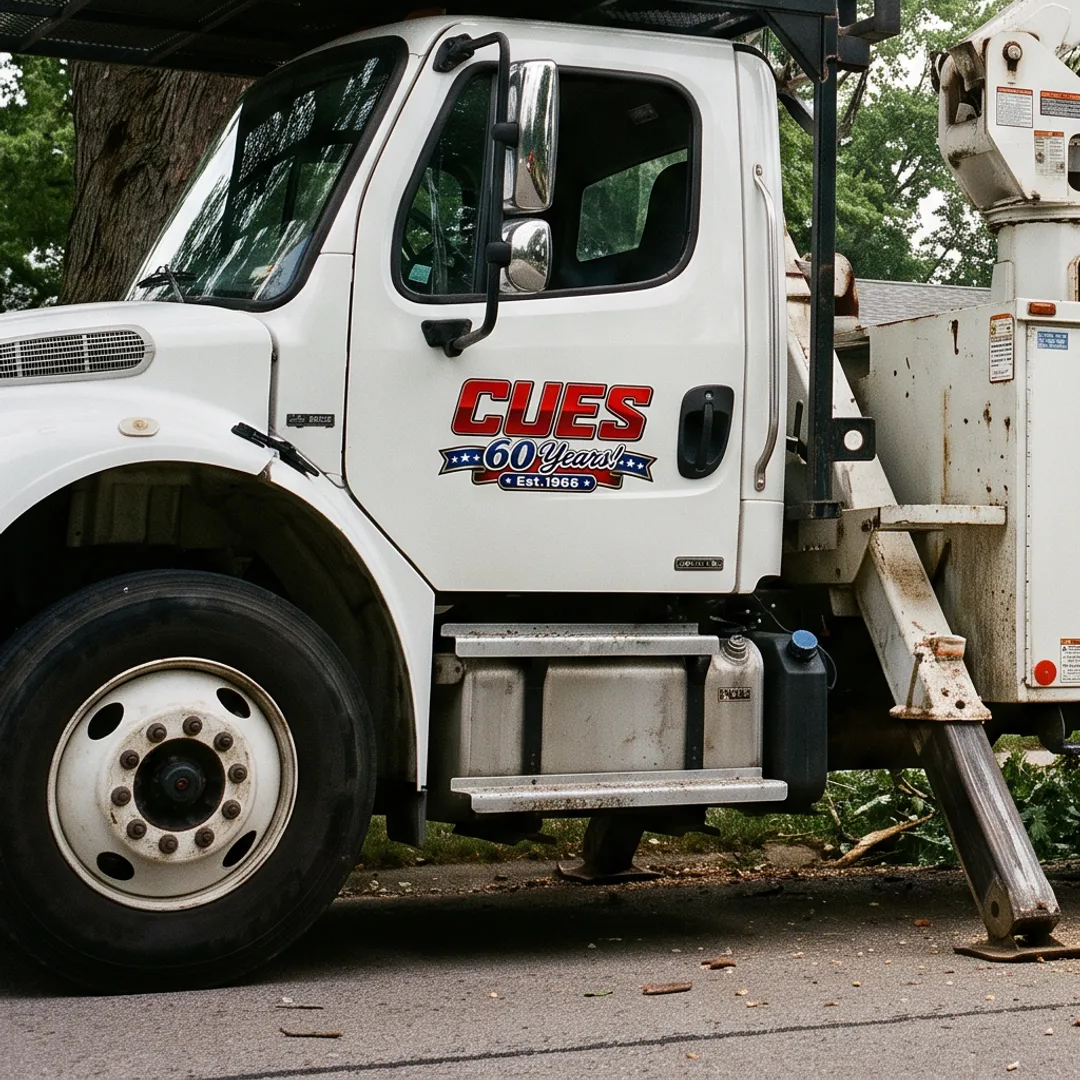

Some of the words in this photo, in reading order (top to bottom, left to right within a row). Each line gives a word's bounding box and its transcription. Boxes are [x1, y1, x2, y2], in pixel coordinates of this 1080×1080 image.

[451, 378, 654, 441] CUES
[483, 438, 537, 471] 60
[538, 440, 626, 474] Years!
